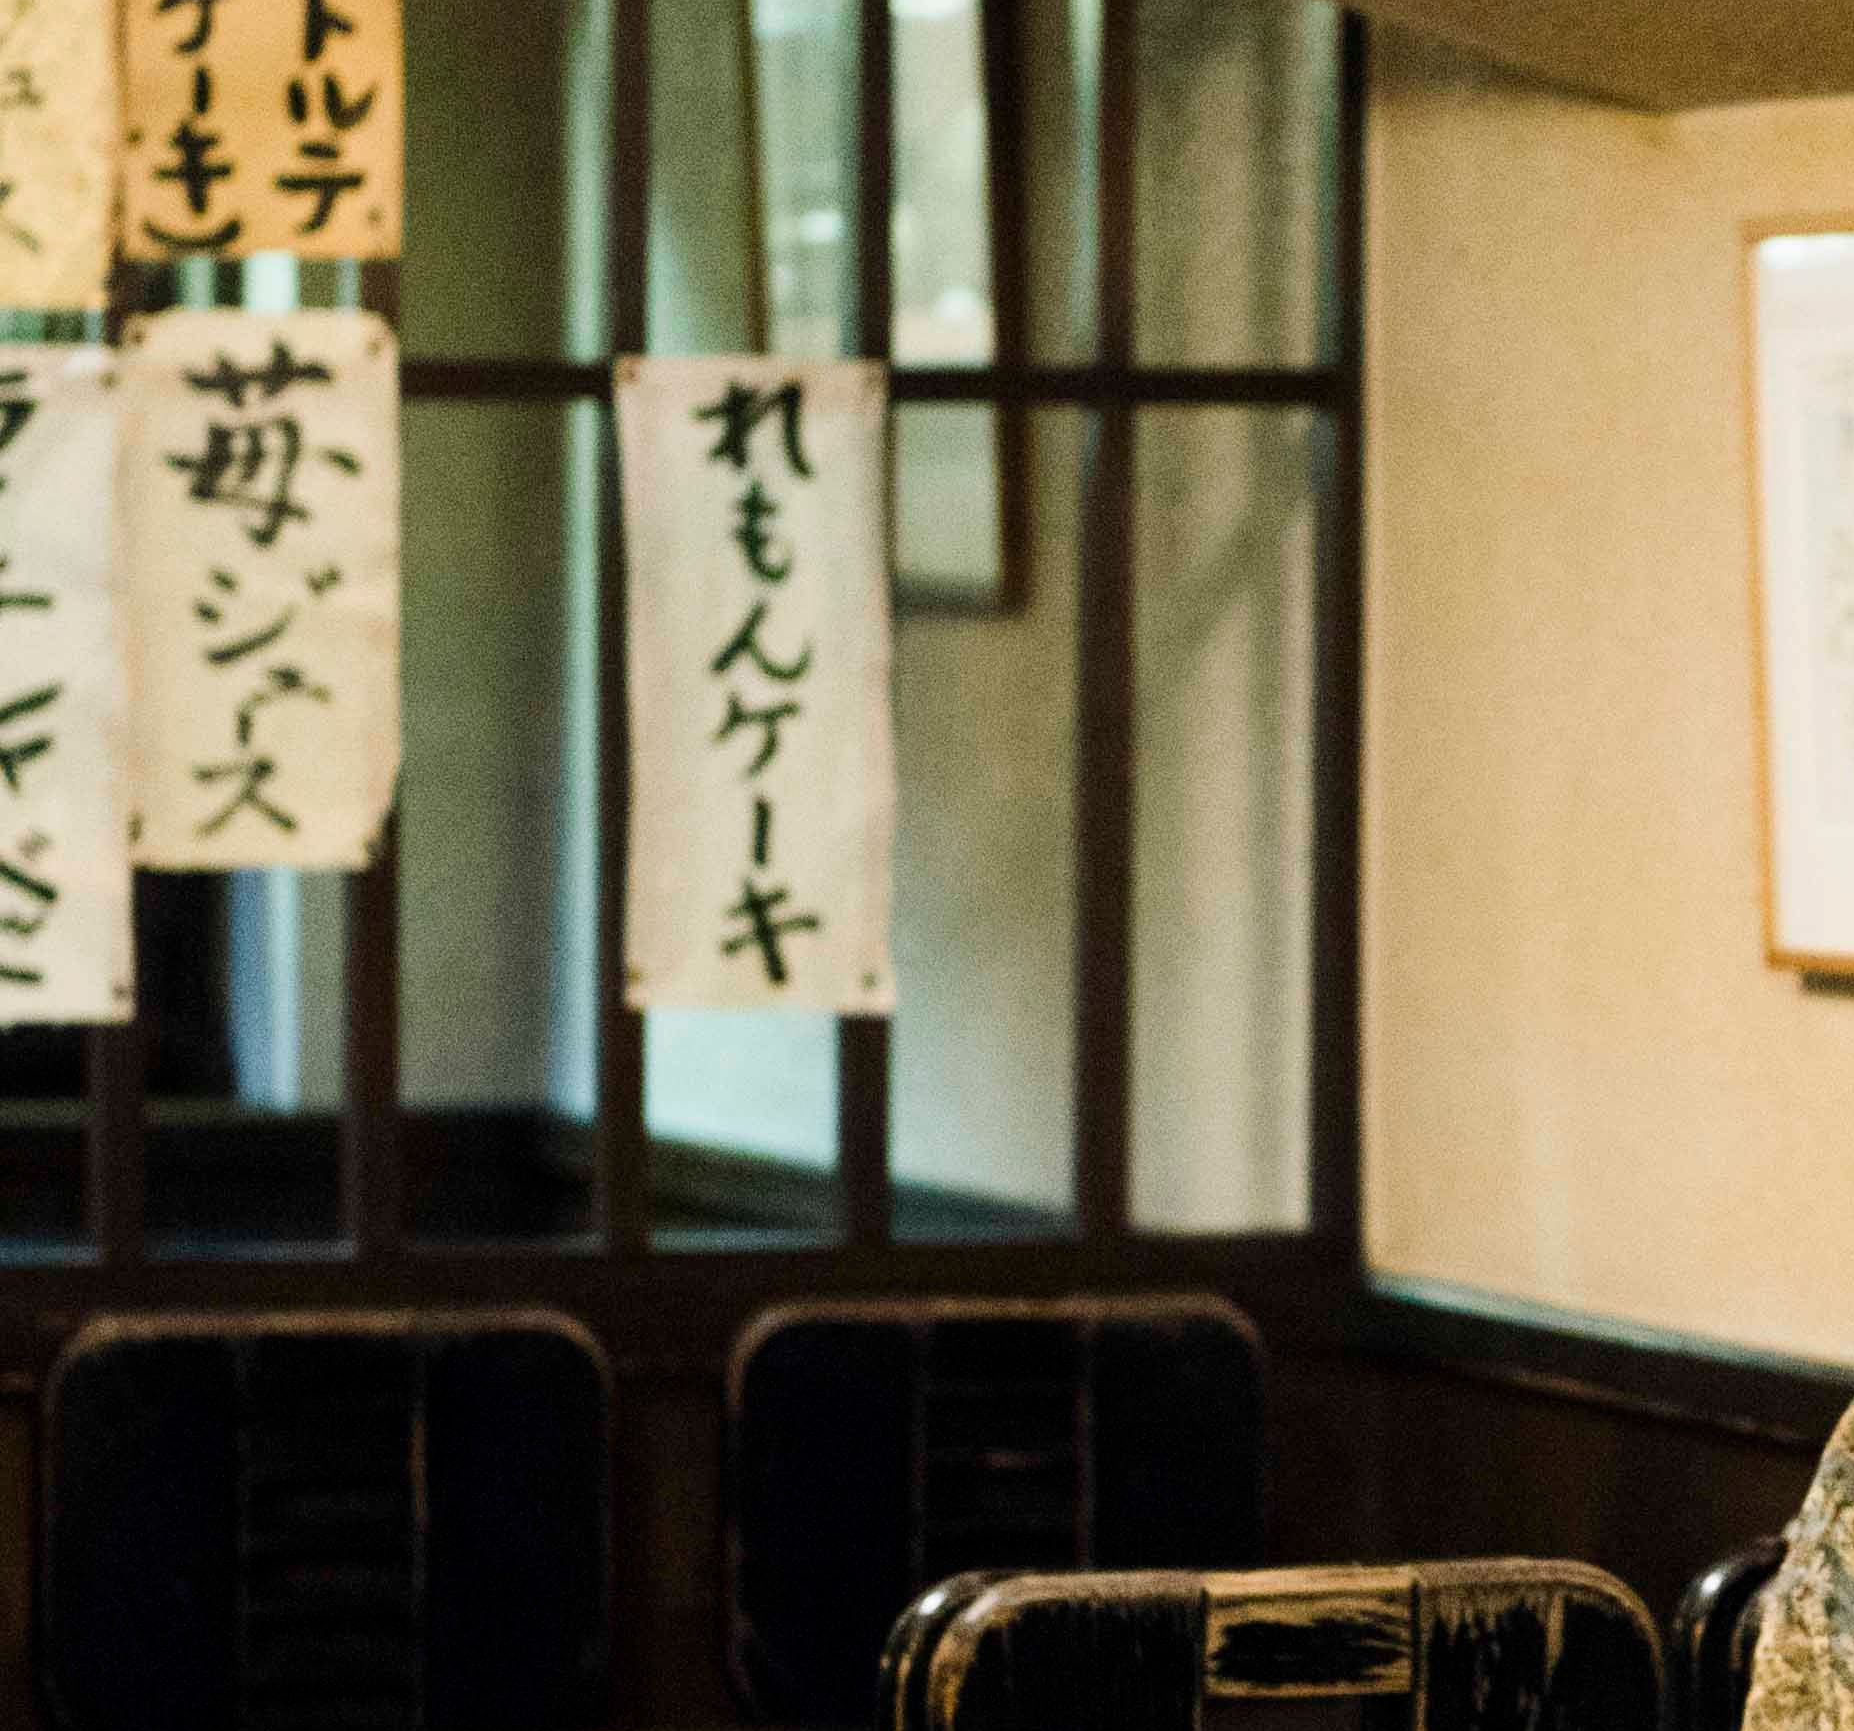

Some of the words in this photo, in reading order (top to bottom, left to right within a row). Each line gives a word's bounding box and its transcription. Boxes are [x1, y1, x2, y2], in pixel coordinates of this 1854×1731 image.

[691, 378, 821, 989] れもんケーキ
